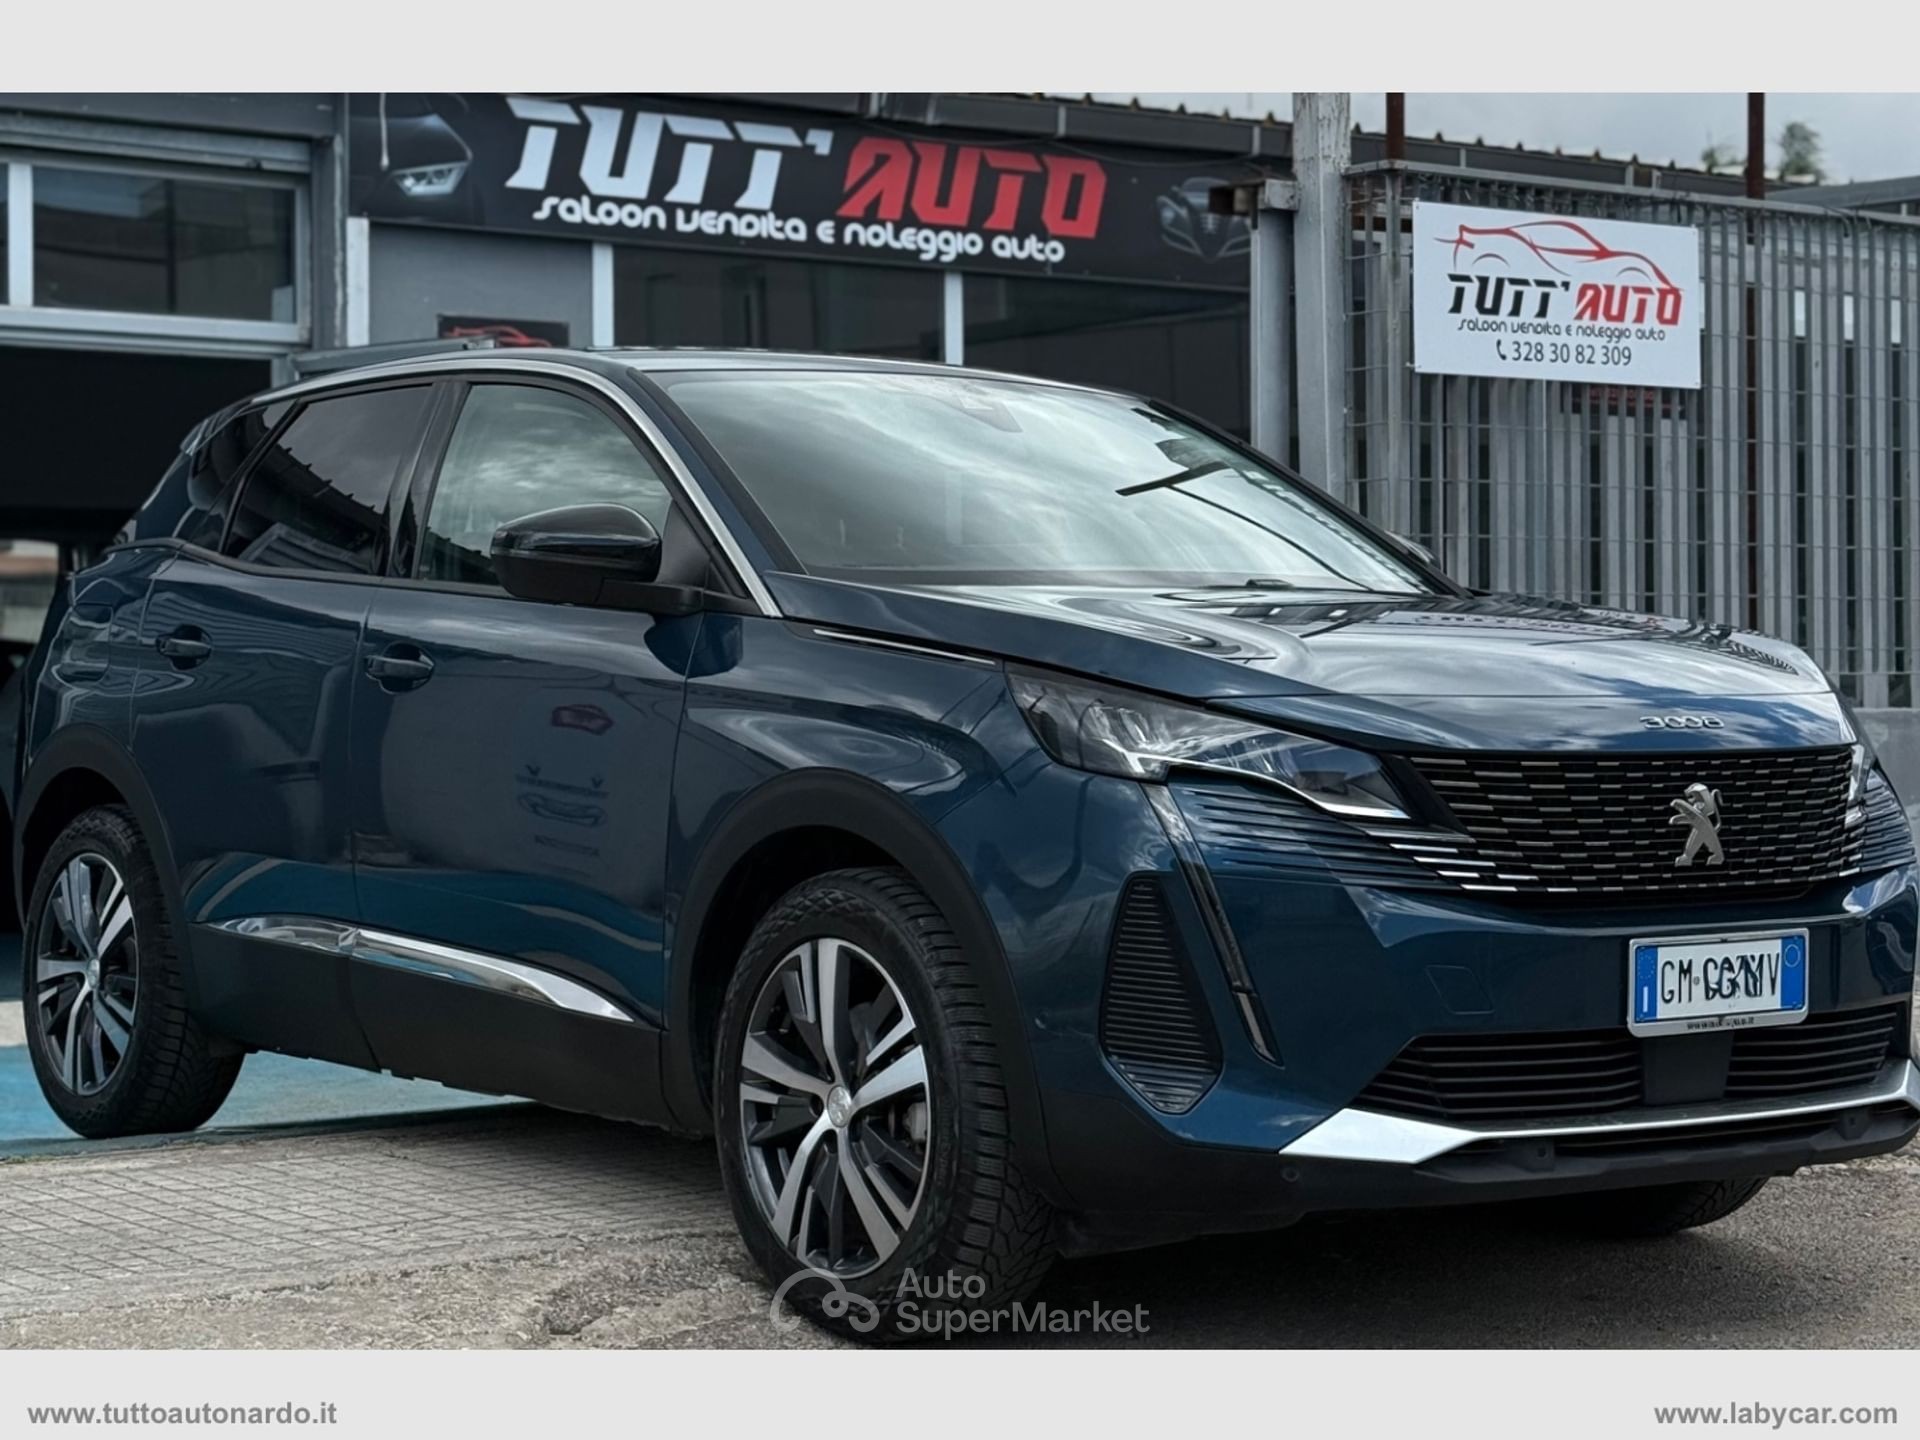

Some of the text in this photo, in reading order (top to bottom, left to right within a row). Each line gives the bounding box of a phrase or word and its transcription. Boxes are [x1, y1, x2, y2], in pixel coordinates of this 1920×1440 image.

[504, 97, 1107, 238] TUTT' AUTO
[991, 234, 1066, 262] auto
[1447, 273, 1683, 326] TUTT' AUTO
[1635, 328, 1666, 341] auto
[1511, 341, 1632, 366] 328 30 82 309
[1640, 715, 1725, 729] 3008
